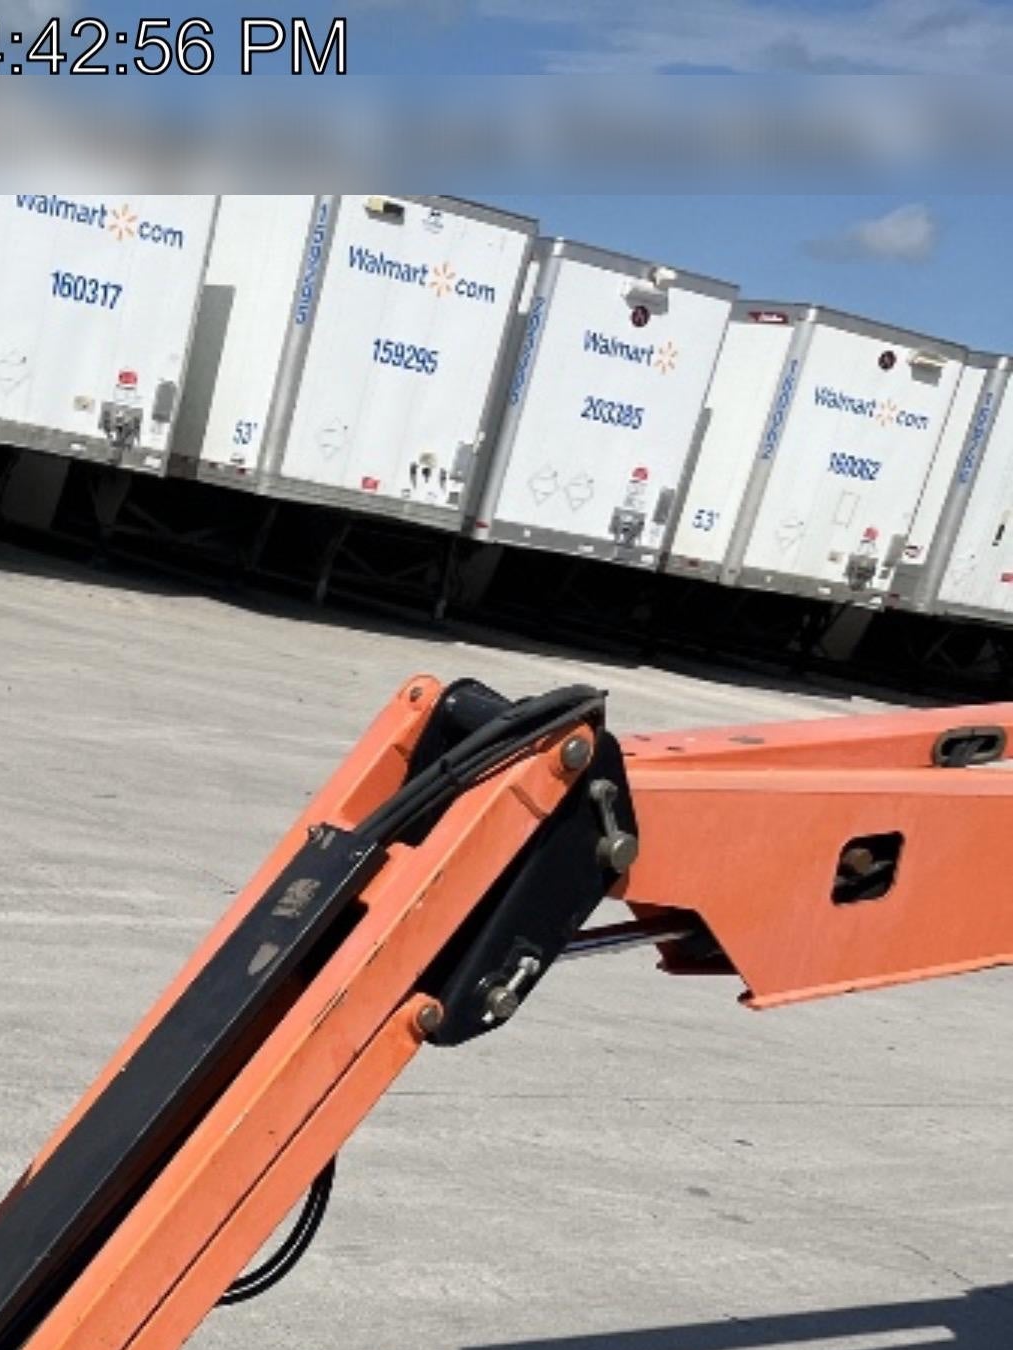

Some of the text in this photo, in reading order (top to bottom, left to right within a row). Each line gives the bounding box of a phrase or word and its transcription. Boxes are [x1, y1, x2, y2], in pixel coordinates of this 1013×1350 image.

[51, 270, 123, 310] 160317
[349, 245, 495, 303] Walmart com
[373, 338, 439, 375] 159295
[584, 330, 653, 366] Walmart
[814, 387, 876, 417] Walmart
